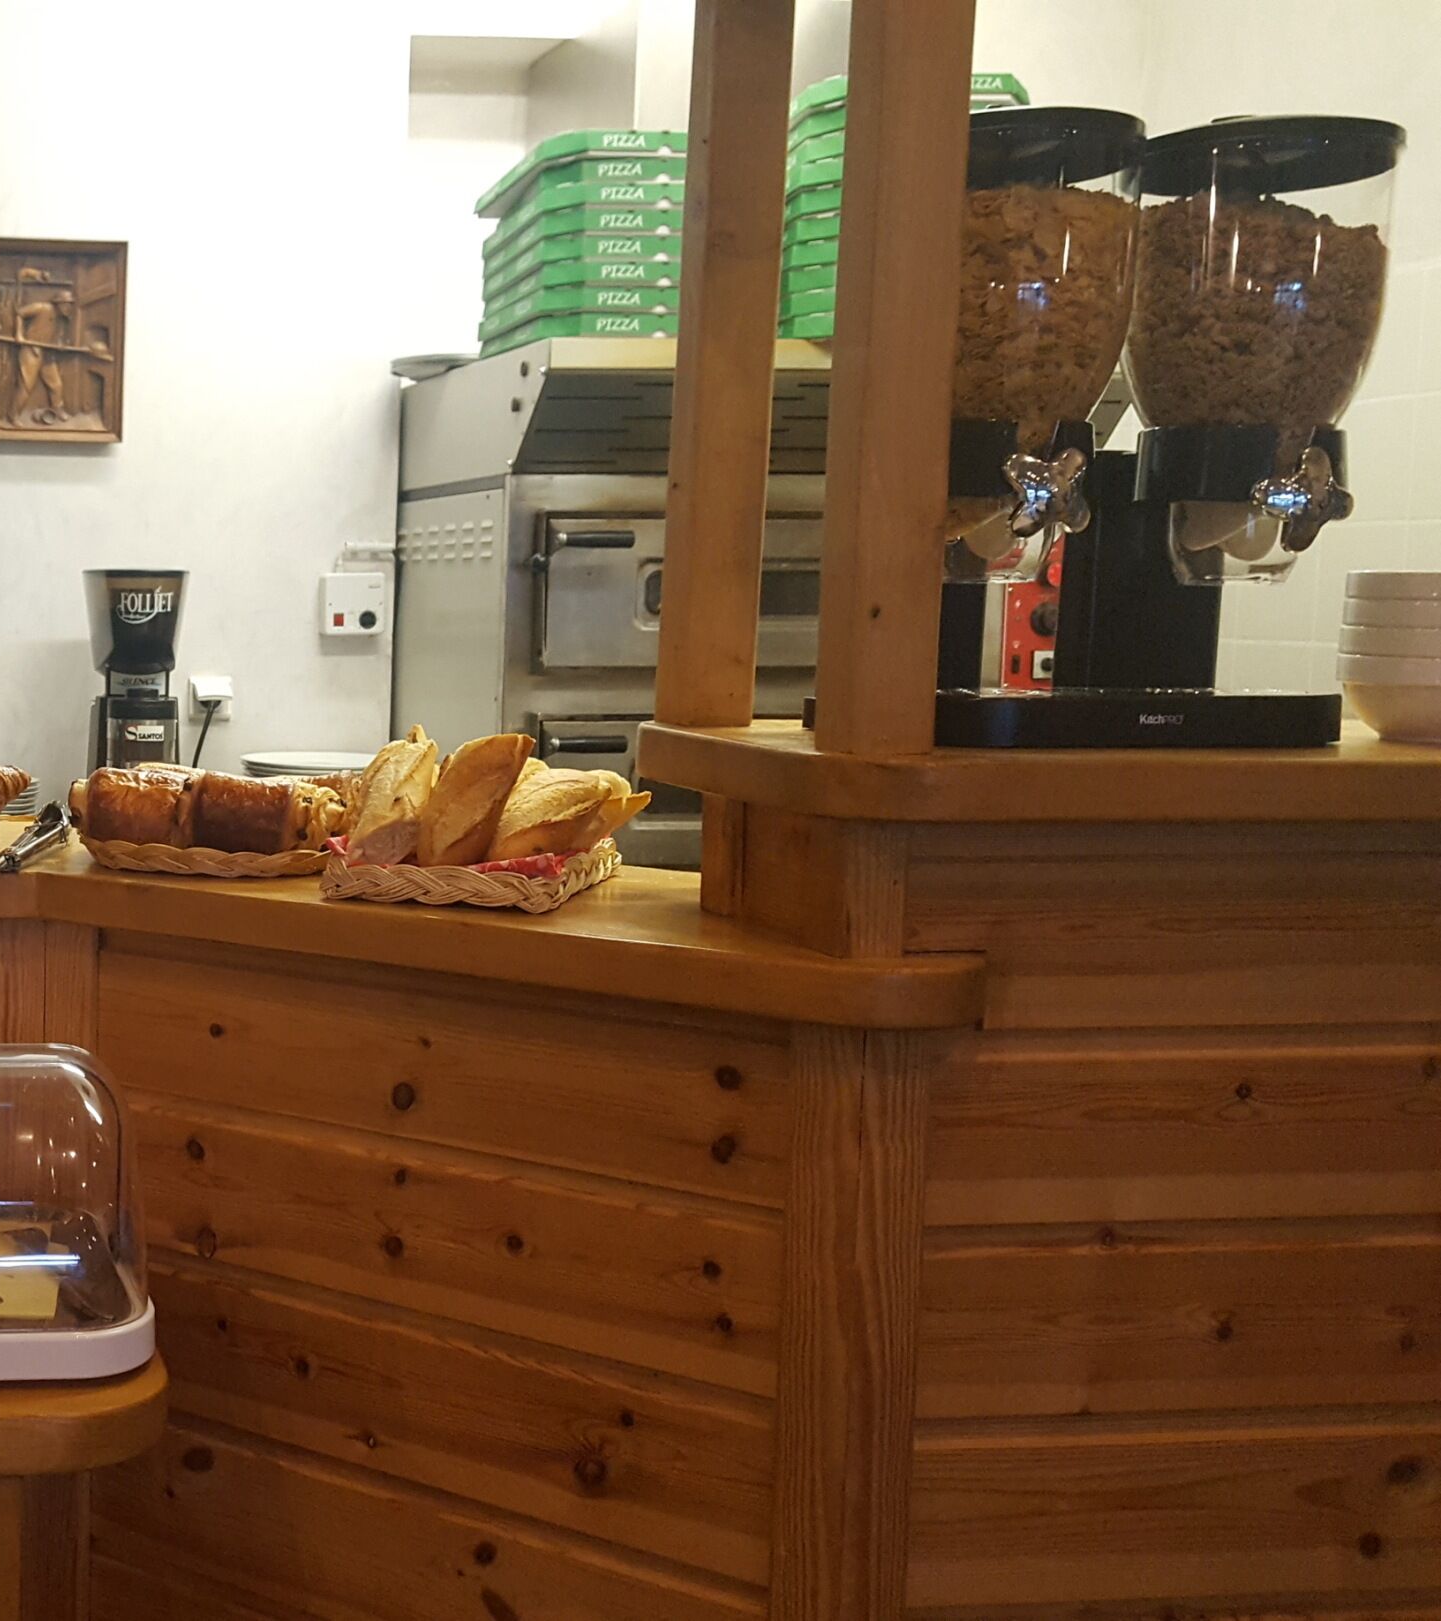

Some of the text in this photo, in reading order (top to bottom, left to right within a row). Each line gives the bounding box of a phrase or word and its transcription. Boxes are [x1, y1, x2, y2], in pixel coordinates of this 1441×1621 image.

[602, 133, 646, 148] PIZZA
[597, 161, 642, 177] PIZZA
[600, 186, 645, 201] PIZZA
[599, 213, 643, 228] PIZZA
[597, 240, 641, 254] PIZZA
[601, 264, 645, 279] PIZZA
[597, 291, 641, 306] PIZZA
[596, 317, 640, 332] PIZZA
